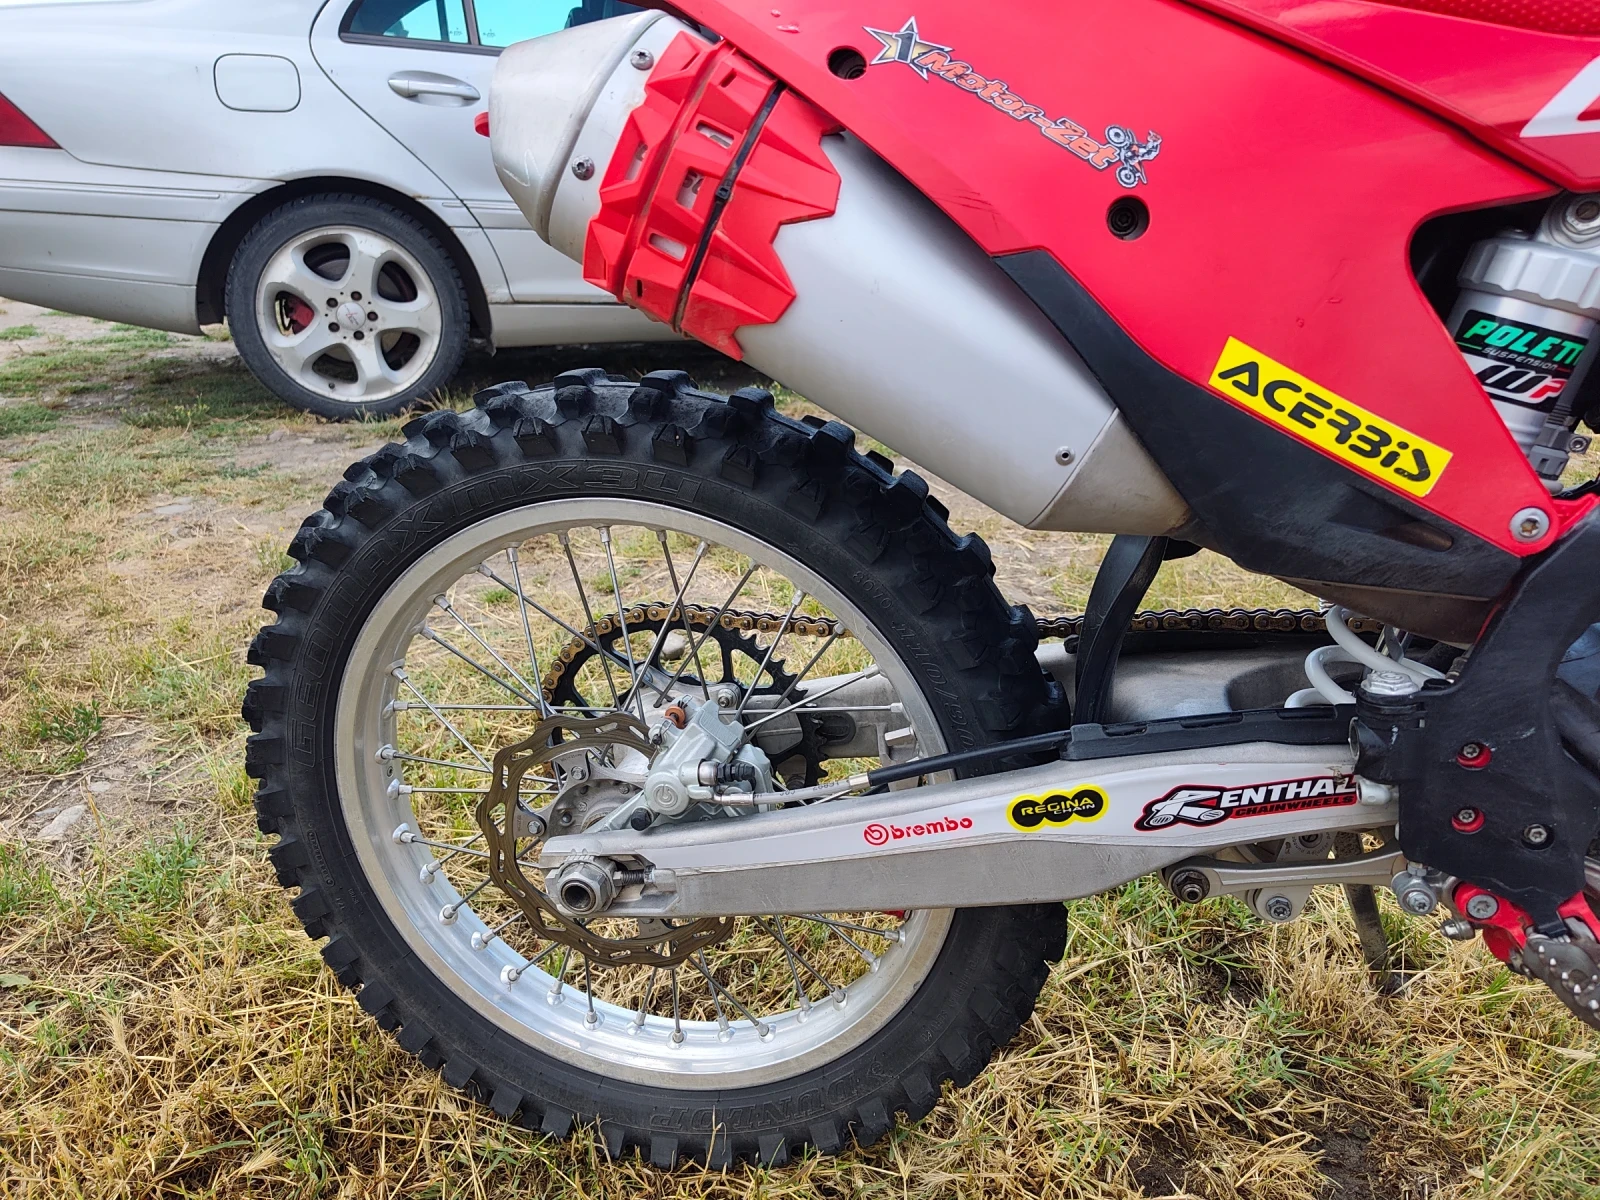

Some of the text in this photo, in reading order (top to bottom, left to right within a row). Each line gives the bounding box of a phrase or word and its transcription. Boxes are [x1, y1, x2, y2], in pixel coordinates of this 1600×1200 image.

[893, 30, 1121, 170] 1 Motor-Zet
[1463, 319, 1586, 366] POLETT
[1482, 347, 1557, 371] SUSPENSION
[1021, 797, 1094, 816] REGINA
[1054, 804, 1096, 815] CHAIN
[1235, 796, 1355, 817] CHAINWHEELS
[891, 817, 973, 840] brembo
[650, 1070, 855, 1131] DUNLOP
